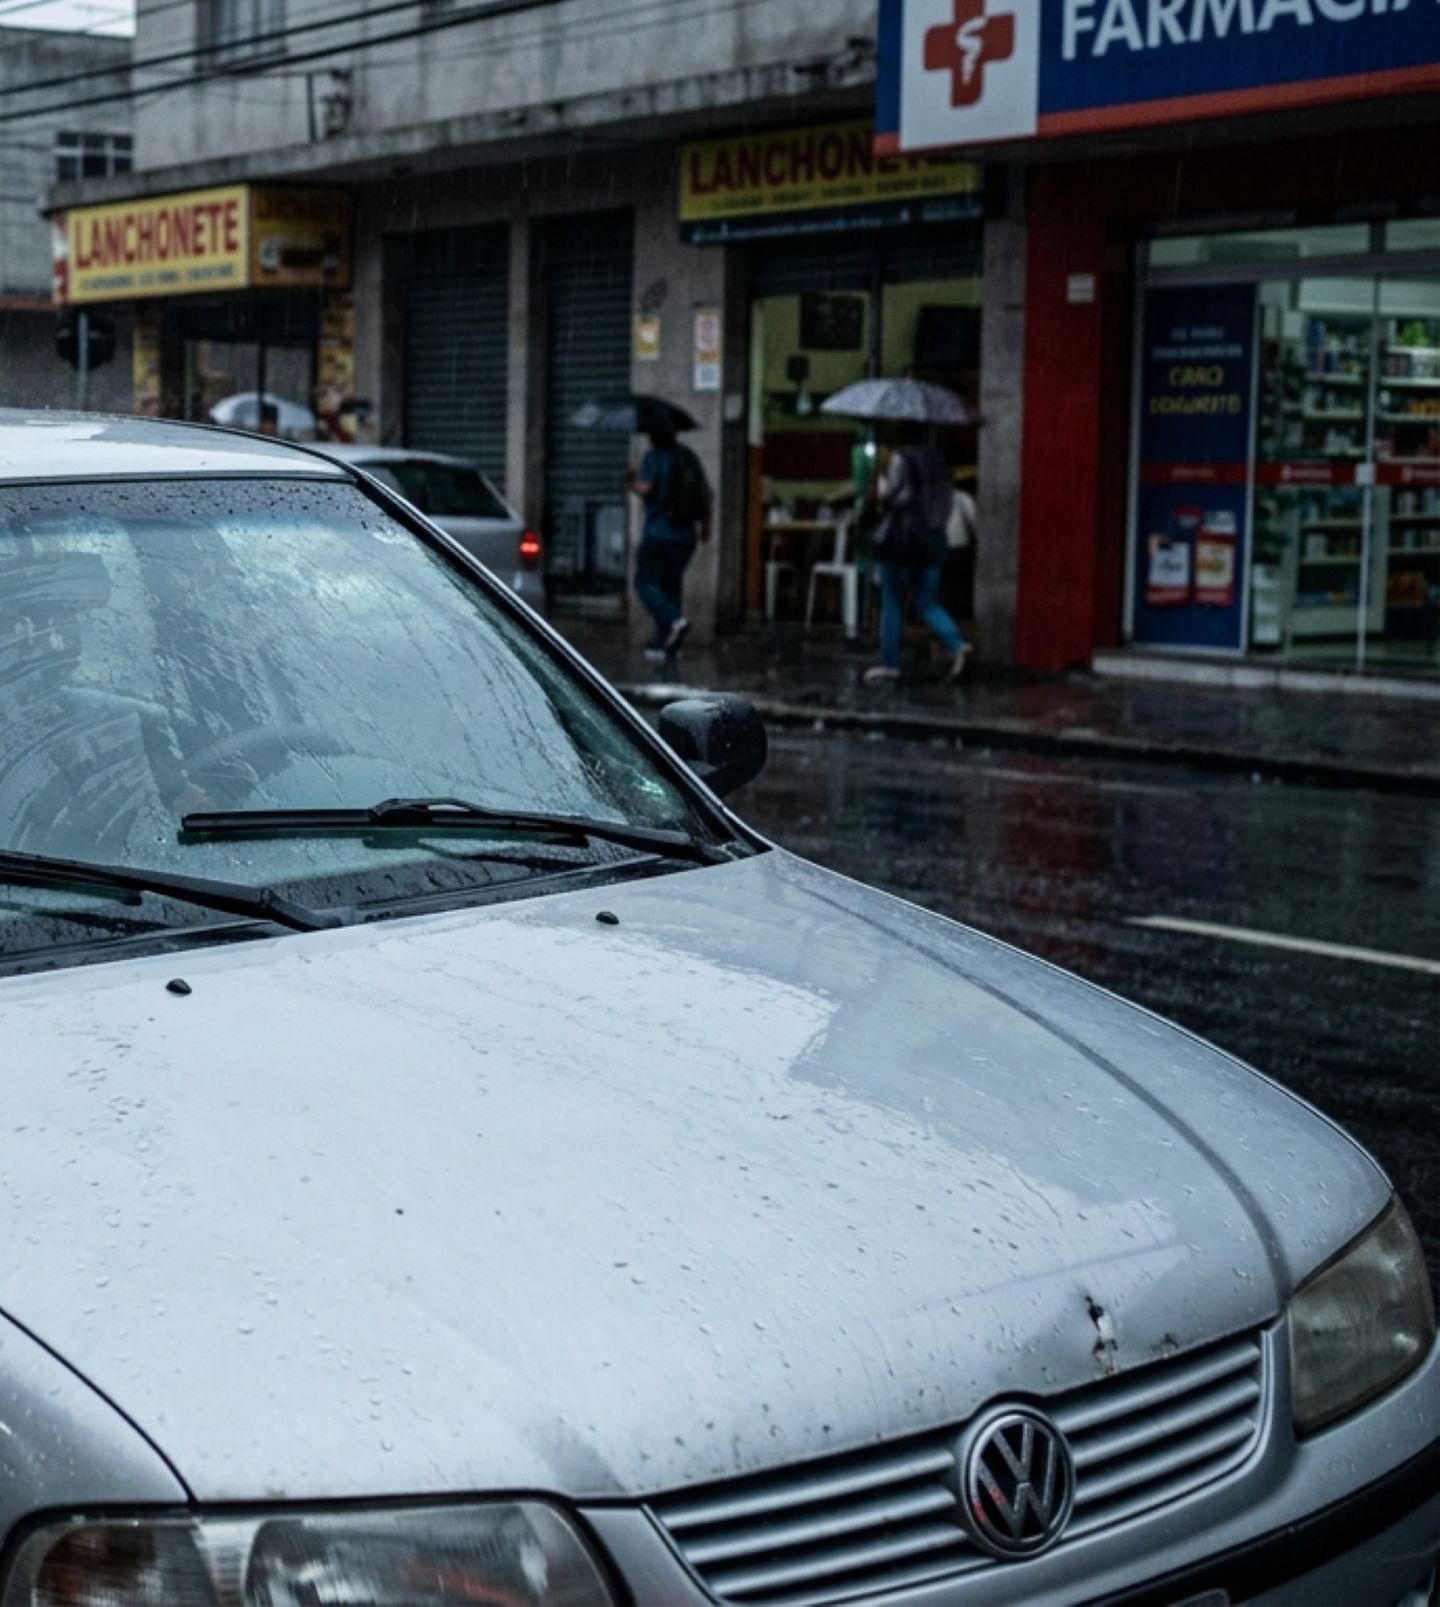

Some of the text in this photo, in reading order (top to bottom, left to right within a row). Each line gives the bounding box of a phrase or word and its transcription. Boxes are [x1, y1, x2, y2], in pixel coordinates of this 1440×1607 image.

[1062, 0, 1440, 60] FARM
[691, 132, 962, 195] LANCHON
[74, 200, 239, 269] LANCHONETE
